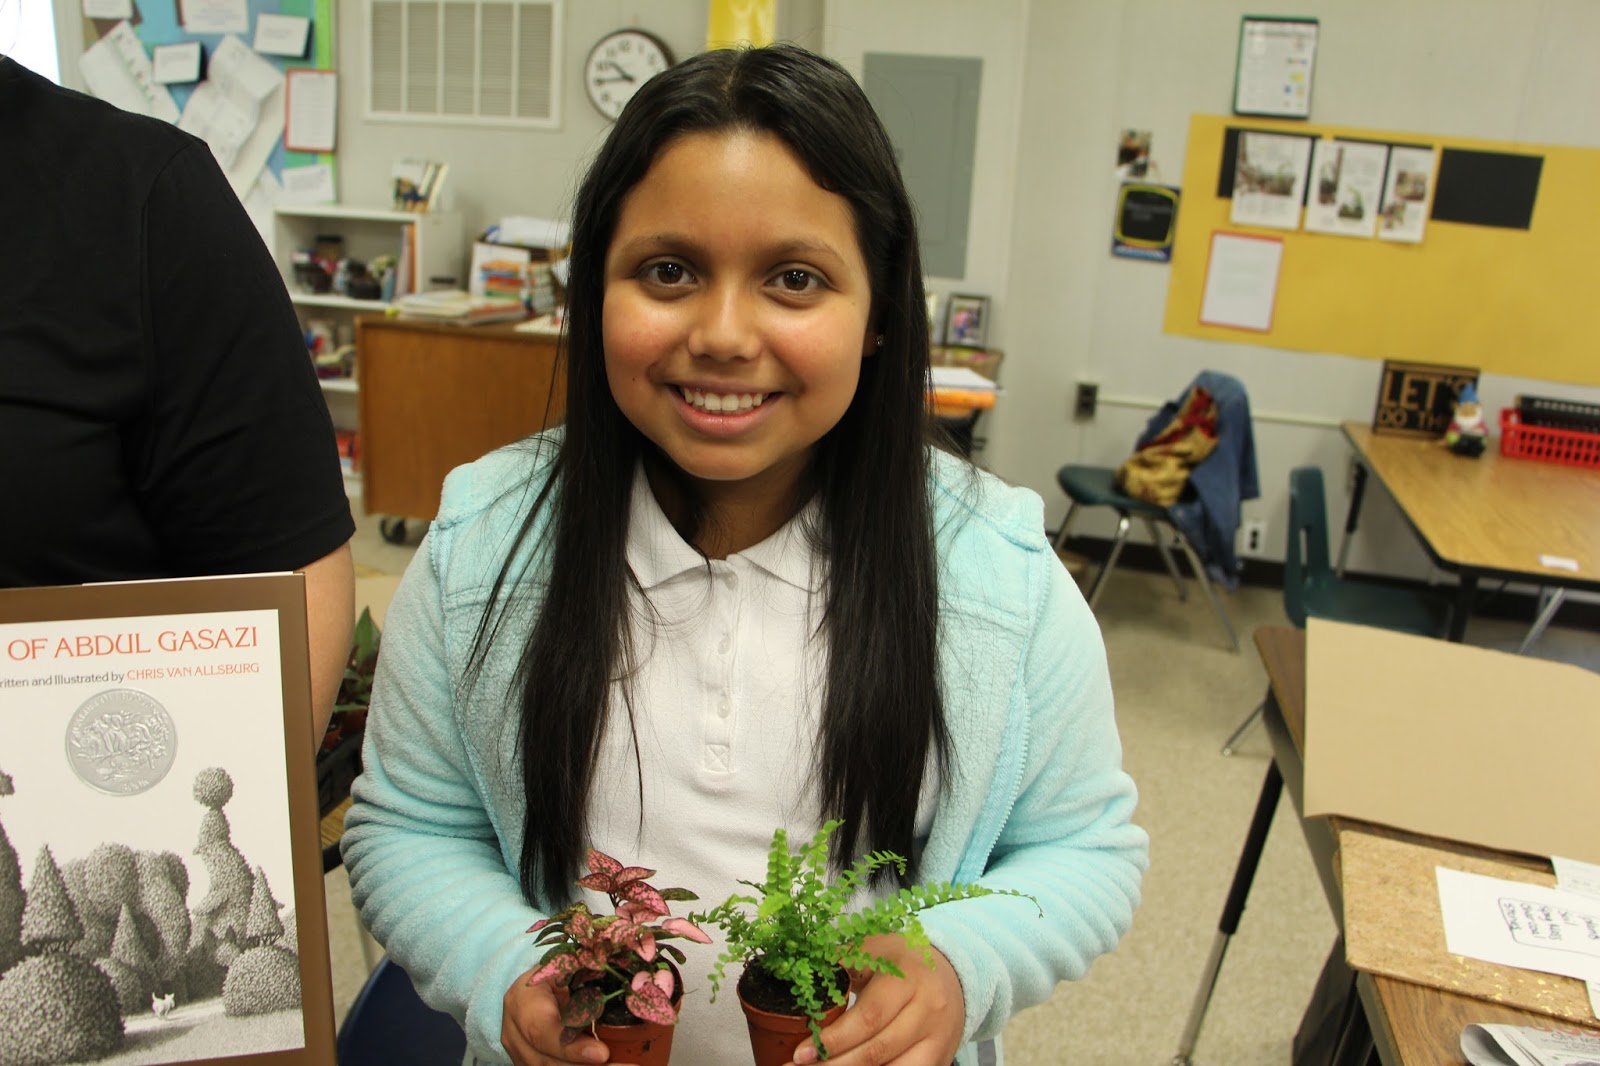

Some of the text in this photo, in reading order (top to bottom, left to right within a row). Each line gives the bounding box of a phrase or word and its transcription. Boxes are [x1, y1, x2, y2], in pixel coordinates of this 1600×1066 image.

[8, 626, 258, 661] OF ABDUL GASAZI
[0, 662, 261, 688] ritten and Illustrated by CHRIS VAN ALLSBURG
